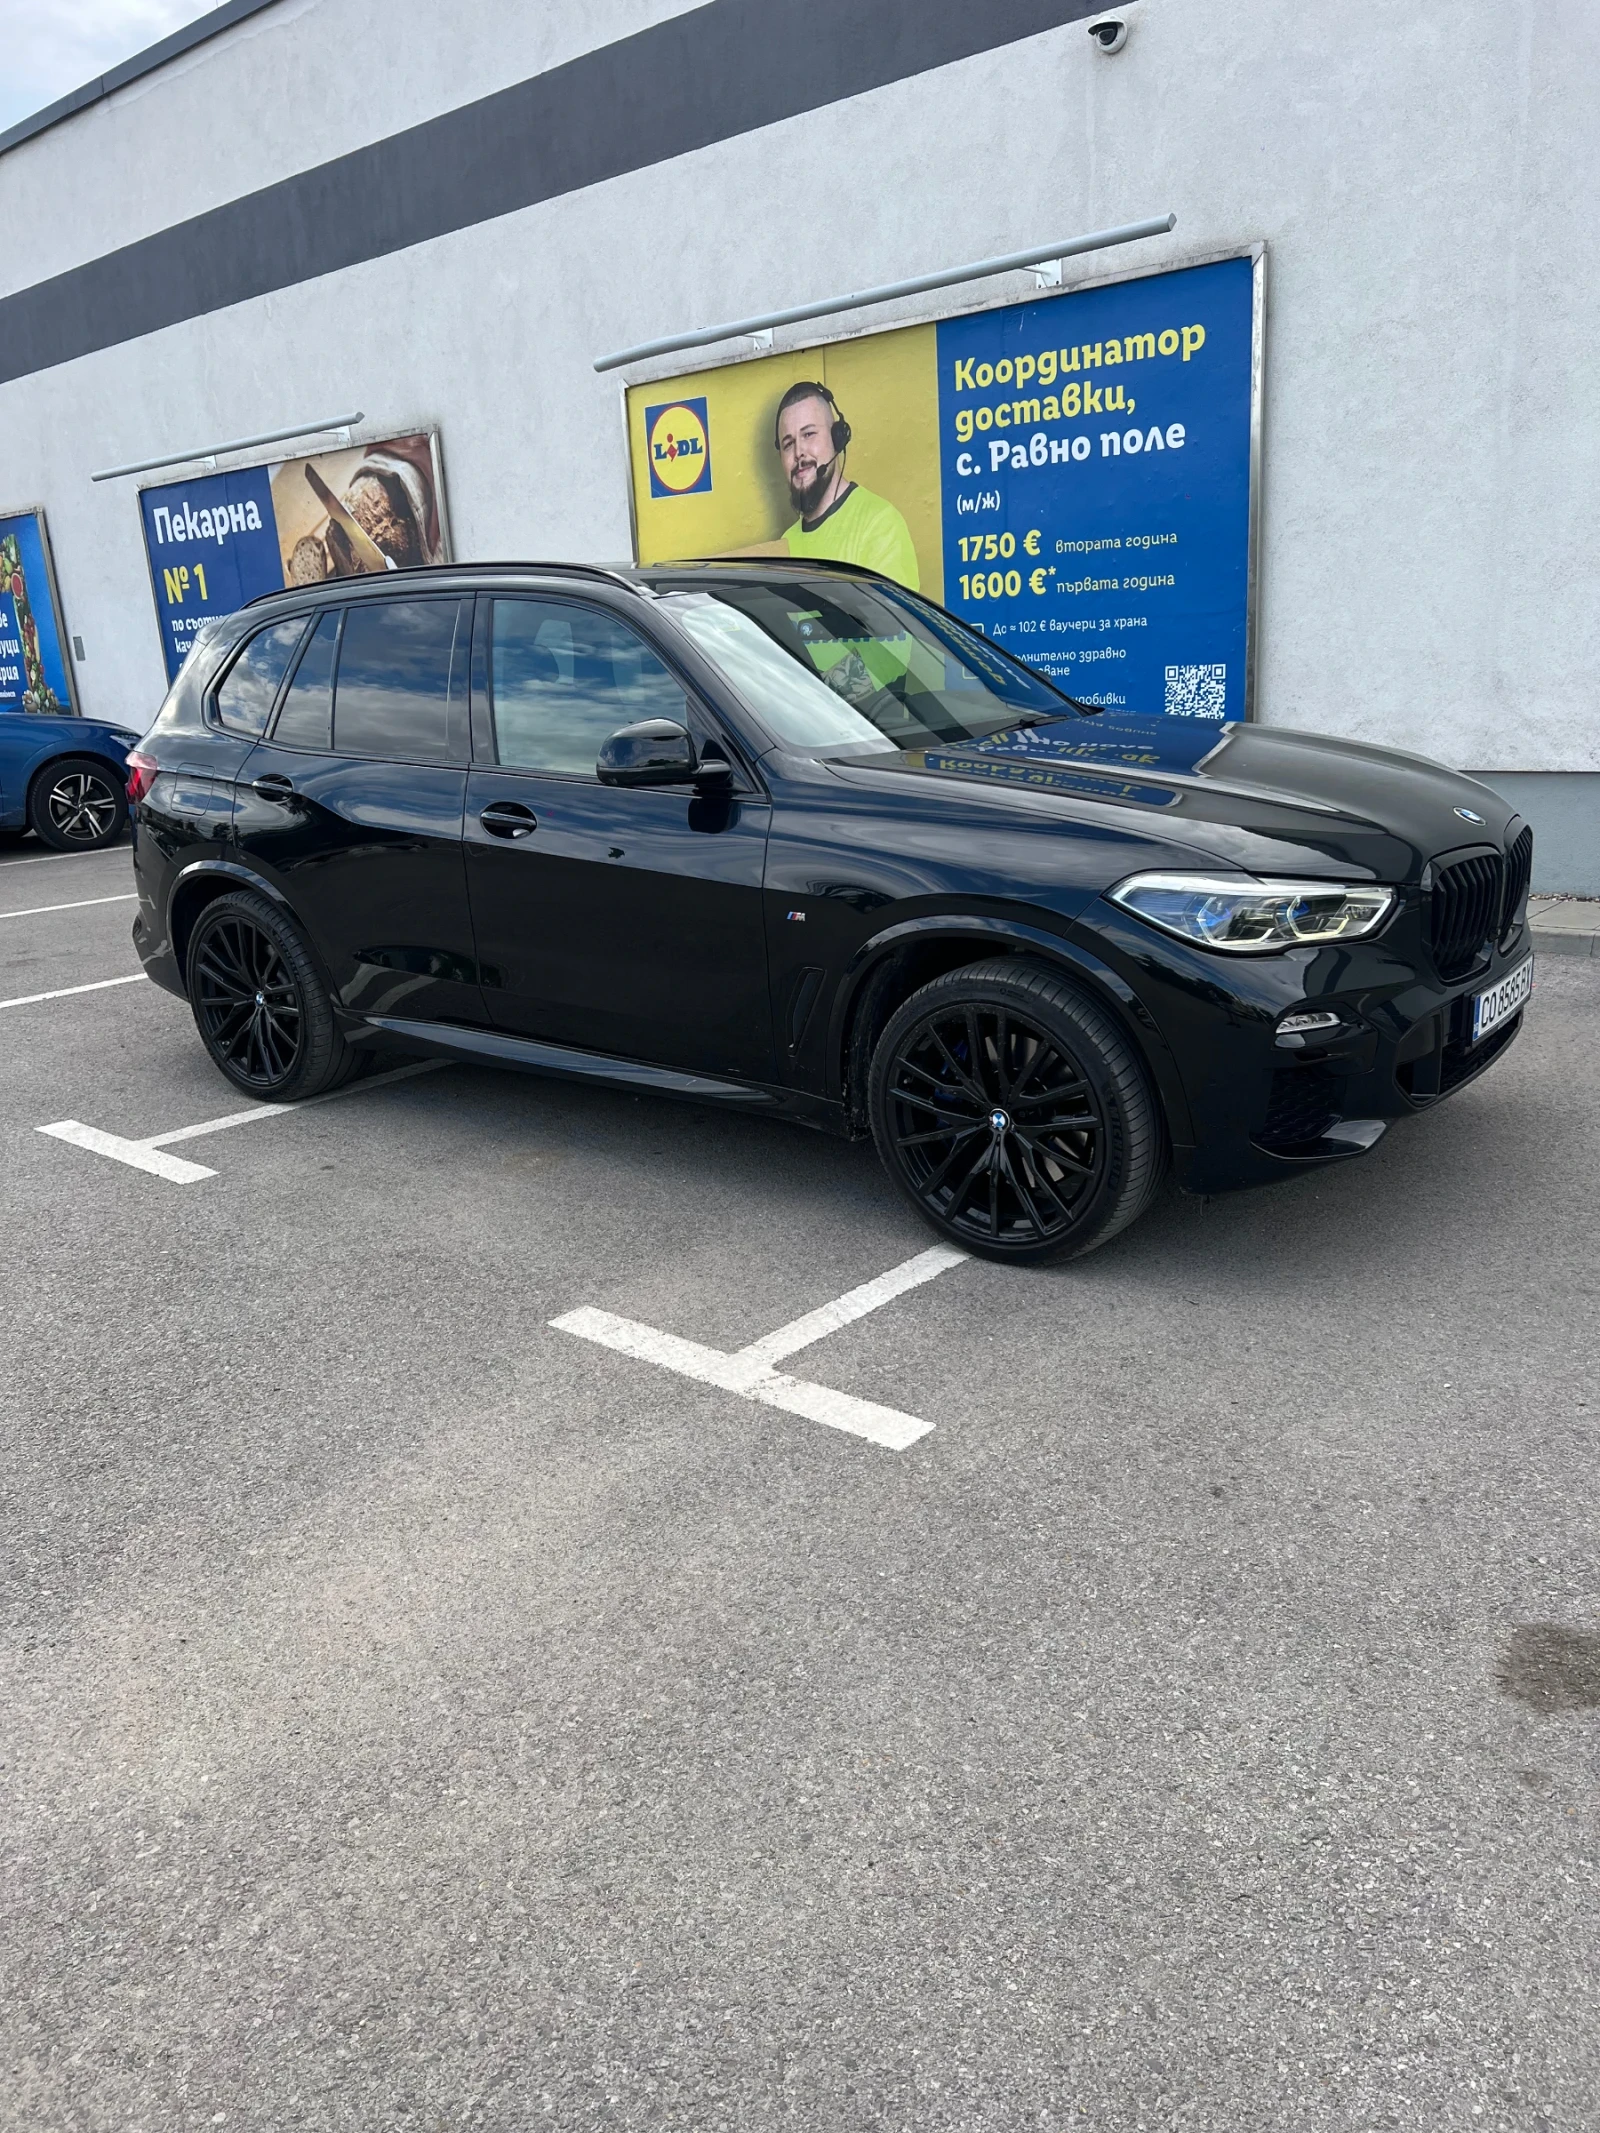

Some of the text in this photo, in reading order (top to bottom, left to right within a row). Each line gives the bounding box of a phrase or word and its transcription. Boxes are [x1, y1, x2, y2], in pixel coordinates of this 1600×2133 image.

[954, 323, 1206, 391] Координатор
[955, 381, 1136, 443] доставки,
[956, 422, 1186, 477] с. Равно поле
[956, 489, 1001, 515] (м/ж)
[153, 500, 263, 546] Пекарна
[958, 529, 1178, 562] 1750 € втората година
[193, 563, 208, 600] 1
[959, 570, 1021, 600] 1600
[1056, 576, 1119, 595] първата
[1123, 574, 1175, 591] година
[171, 619, 184, 631] по
[993, 623, 1007, 636] До
[1018, 620, 1037, 633] 102
[1049, 619, 1096, 633] ваучери
[1098, 619, 1111, 631] за
[1113, 616, 1148, 630] храна
[1079, 646, 1127, 663] здравно
[1482, 992, 1496, 1028] CO
[1498, 972, 1520, 1016] 8585
